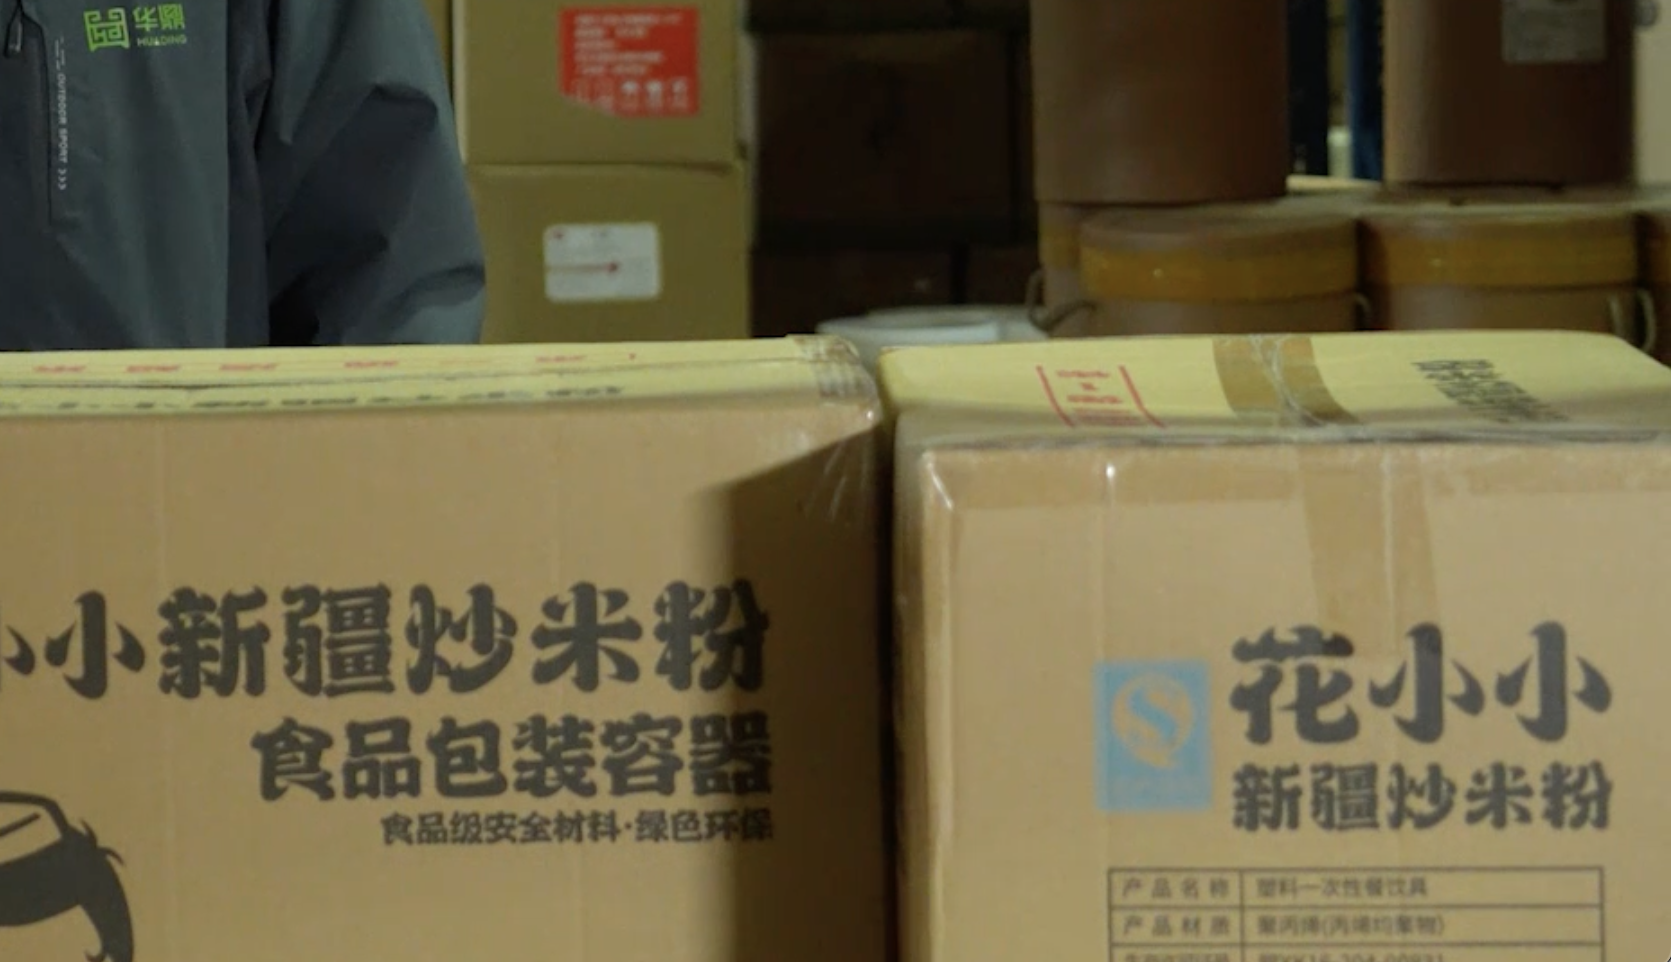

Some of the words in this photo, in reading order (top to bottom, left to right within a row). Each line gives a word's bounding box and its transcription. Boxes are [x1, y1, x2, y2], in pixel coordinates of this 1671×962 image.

[132, 3, 186, 32] 华鼎
[136, 34, 188, 47] HUADING
[57, 73, 68, 124] OUTDOOR
[58, 127, 69, 164] SPORT
[1229, 622, 1613, 745] 花小小
[251, 710, 772, 802] 食品包装容器
[1232, 761, 1613, 832] 新疆炒米粉
